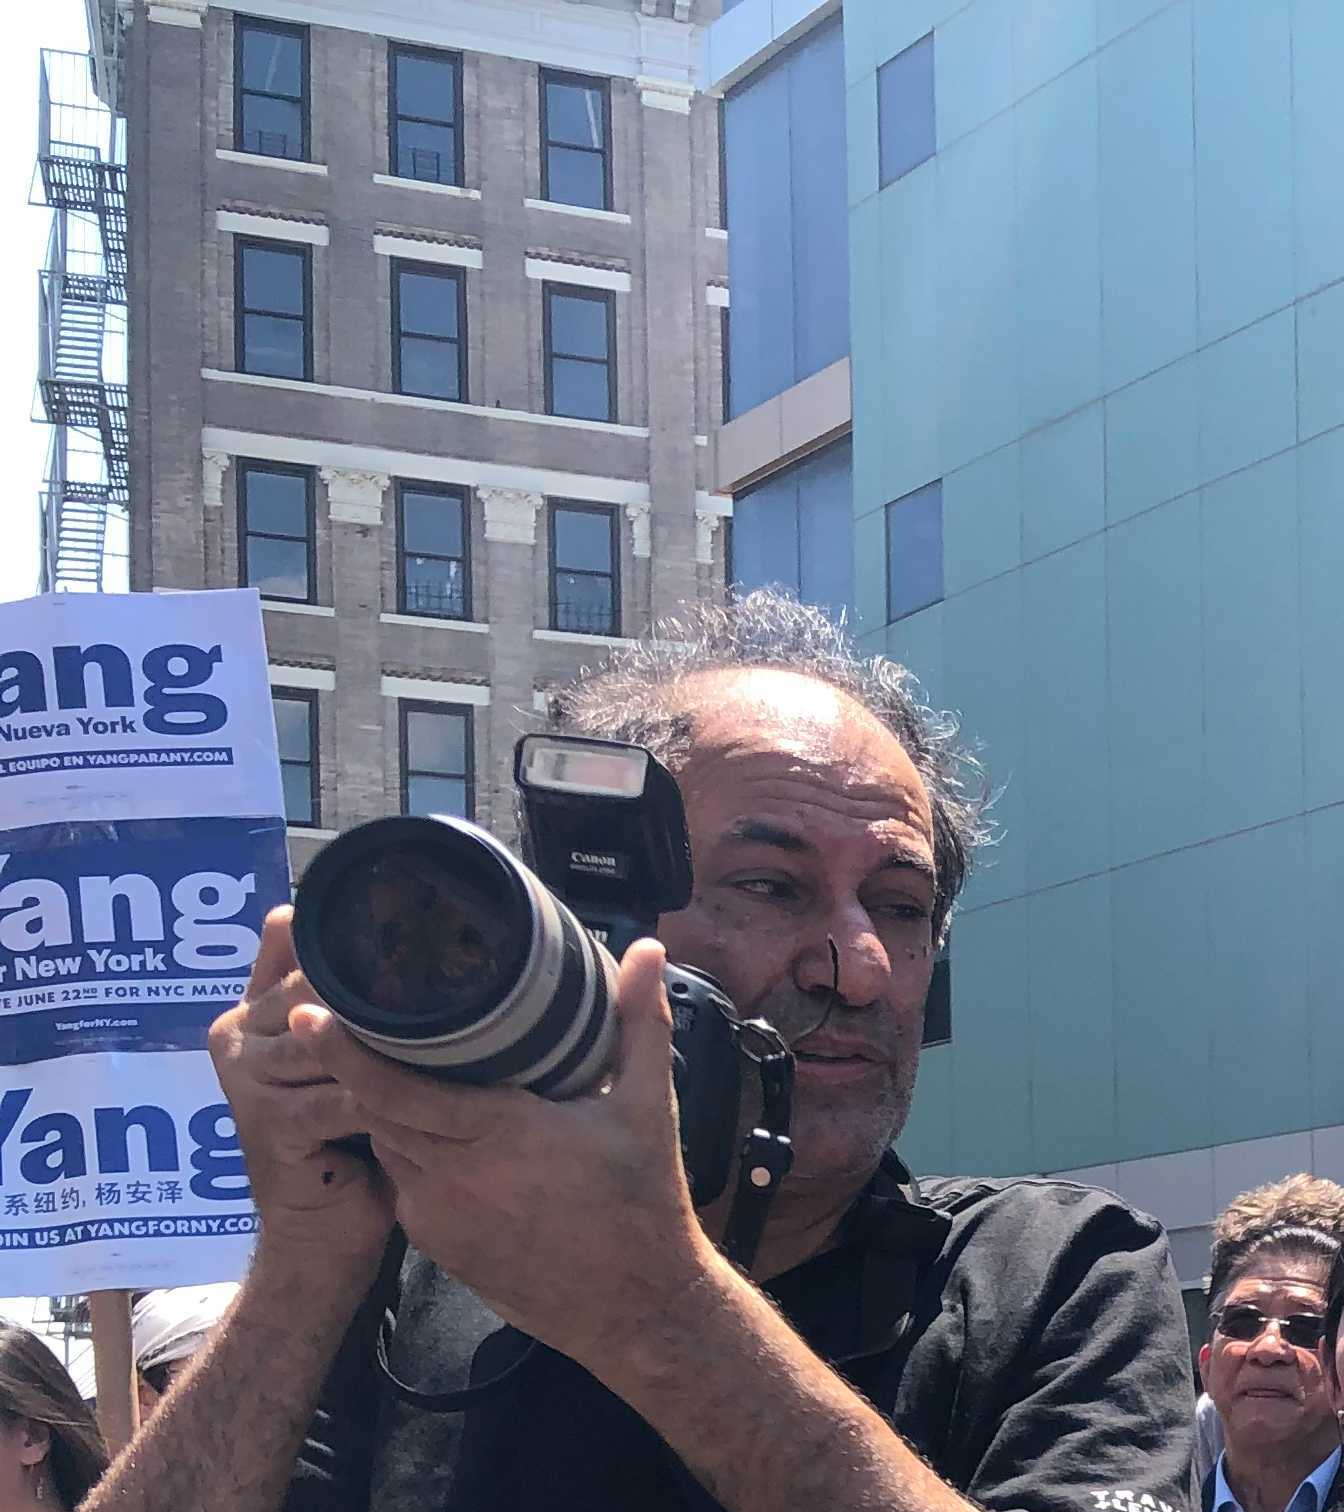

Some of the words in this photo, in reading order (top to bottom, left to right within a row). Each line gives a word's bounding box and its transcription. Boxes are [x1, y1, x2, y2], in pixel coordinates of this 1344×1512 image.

[0, 644, 228, 736] ang
[0, 722, 71, 742] Nueva
[76, 715, 137, 735] York
[9, 758, 60, 773] EQUIPO
[64, 755, 83, 767] EN
[87, 751, 229, 766] YANGPARANY.COM
[571, 851, 616, 867] Canon
[0, 854, 262, 970] ang
[14, 955, 82, 981] New
[87, 948, 167, 973] York
[17, 991, 55, 1007] JUNE
[104, 985, 140, 998] FOR
[147, 985, 185, 997] NYC
[191, 983, 245, 996] MAYO
[35, 1229, 60, 1245] US
[64, 1227, 85, 1243] AT
[86, 1217, 260, 1238] YANGFORNY.CO
